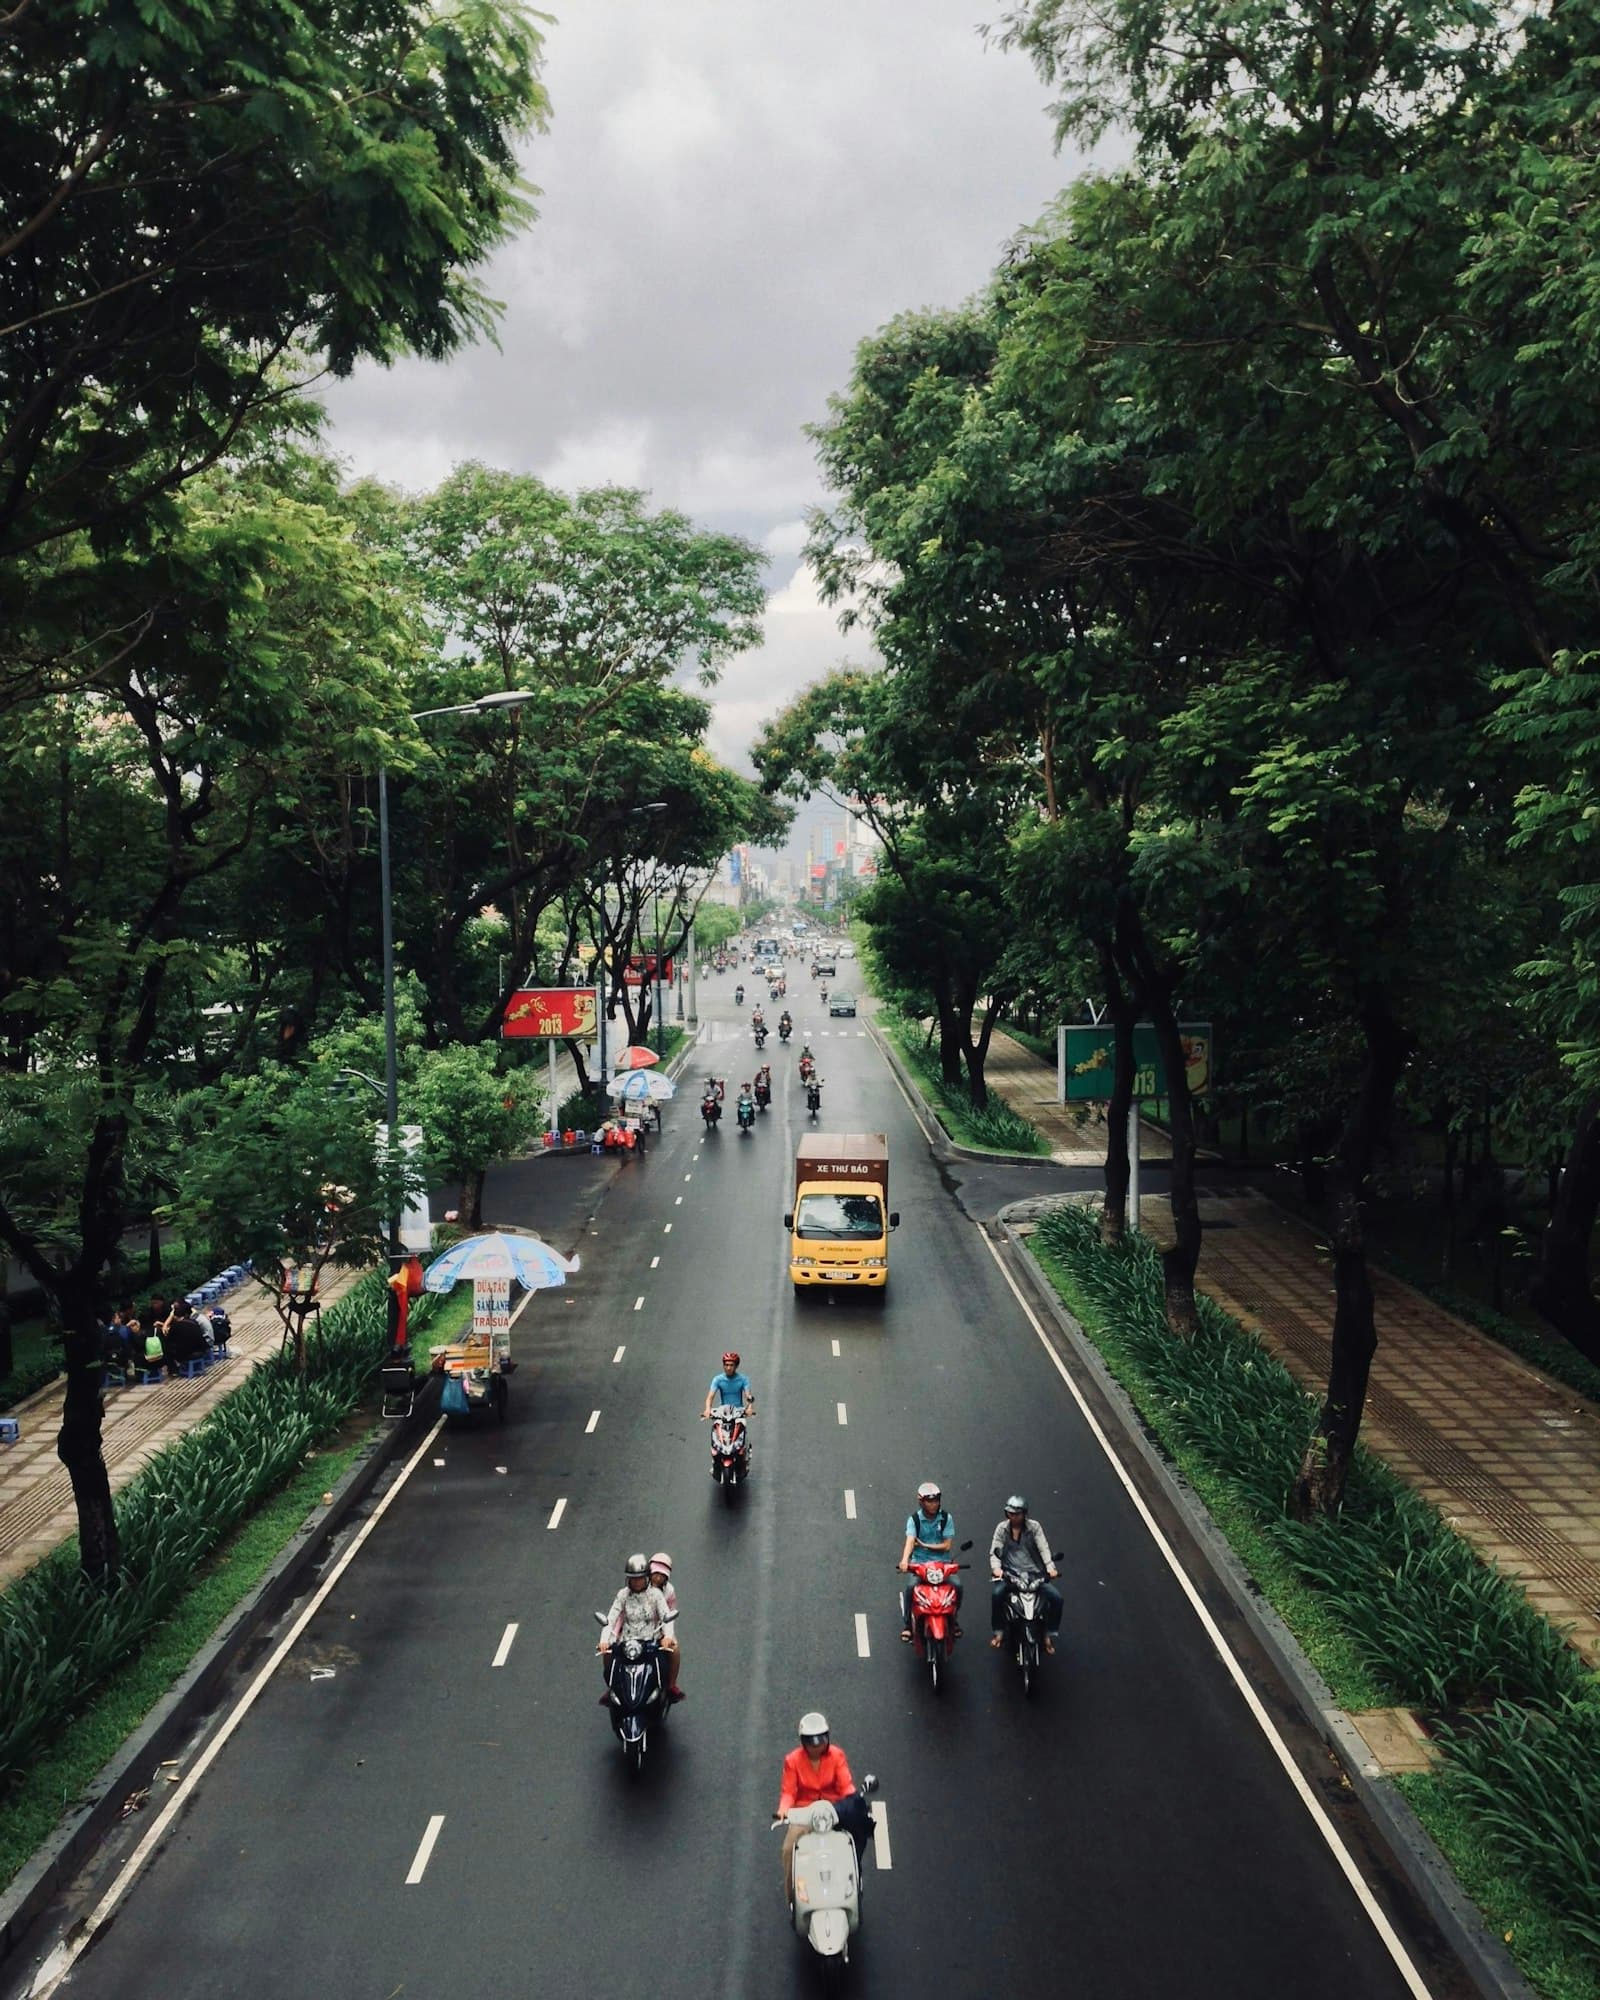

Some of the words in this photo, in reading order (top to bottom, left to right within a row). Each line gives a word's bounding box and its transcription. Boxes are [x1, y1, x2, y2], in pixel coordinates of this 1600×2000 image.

[539, 1018, 562, 1035] 2013
[1132, 1071, 1155, 1095] 013
[817, 1165, 829, 1173] XE
[831, 1164, 848, 1173] THƯ
[850, 1164, 868, 1174] BÁO
